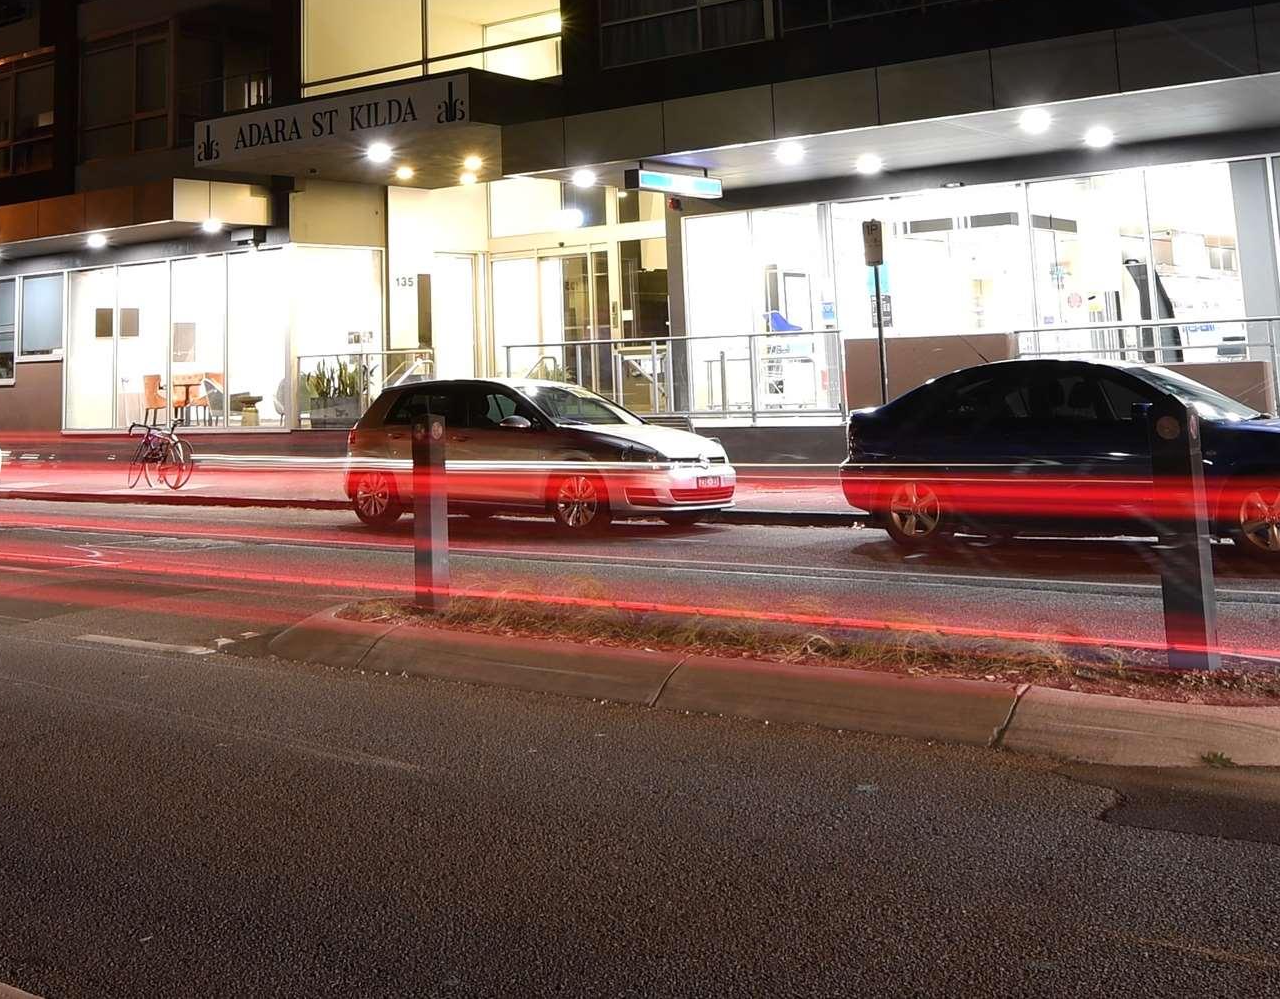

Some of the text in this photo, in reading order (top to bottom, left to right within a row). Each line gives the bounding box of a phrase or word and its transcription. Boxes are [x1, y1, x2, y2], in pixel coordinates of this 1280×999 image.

[234, 97, 417, 150] ADARA ST KILDA
[866, 224, 878, 235] 1P
[396, 276, 414, 287] 135
